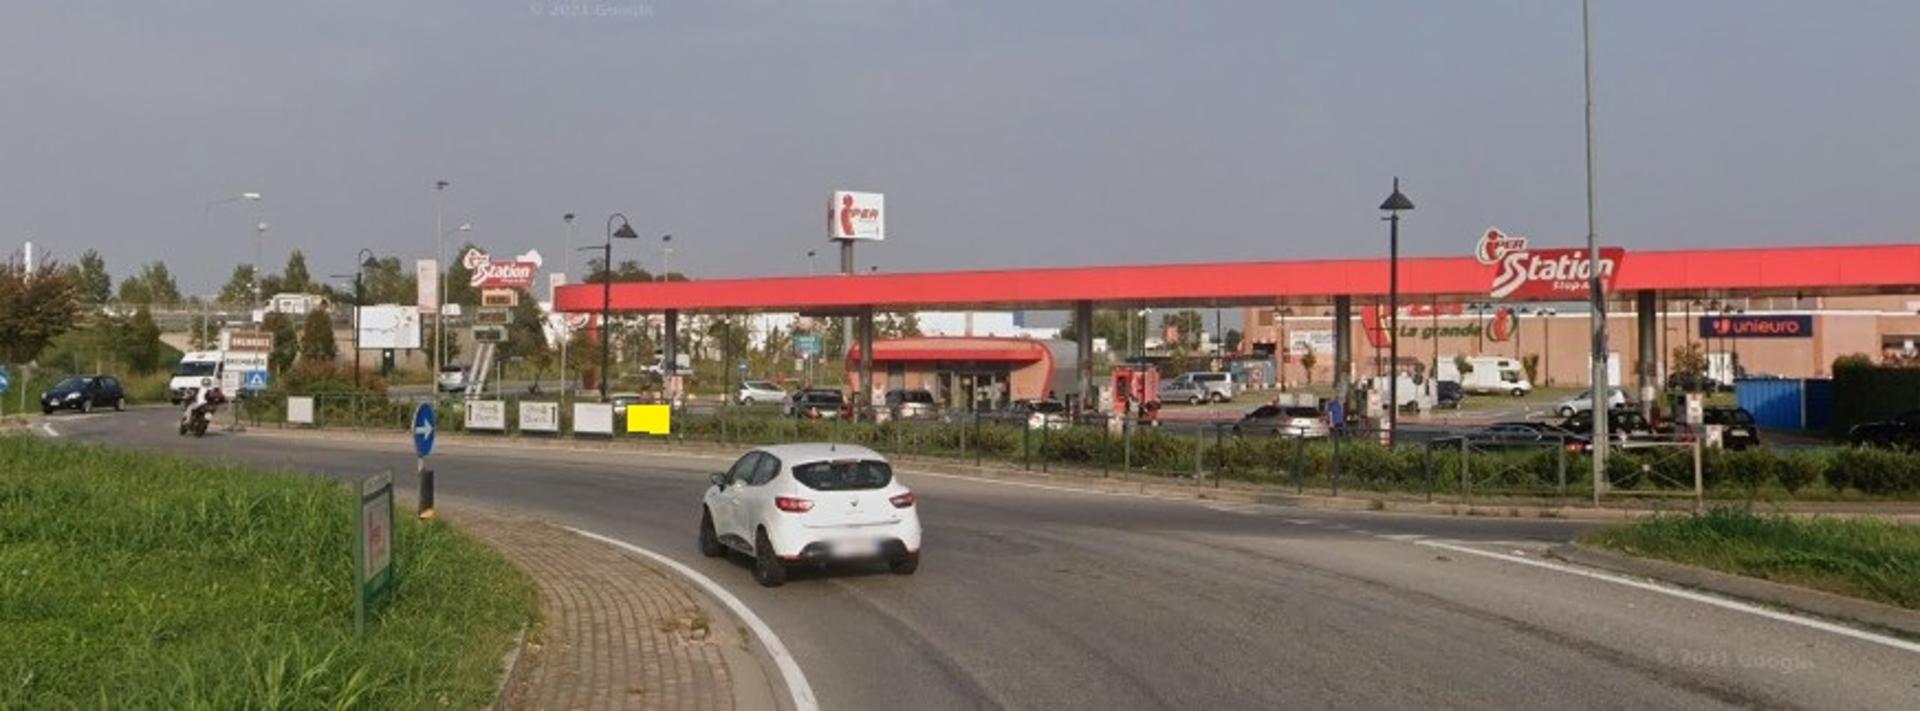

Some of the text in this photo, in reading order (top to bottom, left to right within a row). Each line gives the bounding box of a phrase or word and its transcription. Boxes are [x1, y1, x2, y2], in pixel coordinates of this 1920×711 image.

[470, 261, 530, 287] Station
[1491, 252, 1616, 299] Station
[1399, 325, 1418, 338] La
[1421, 322, 1482, 340] grande
[1734, 320, 1799, 333] unieuro
